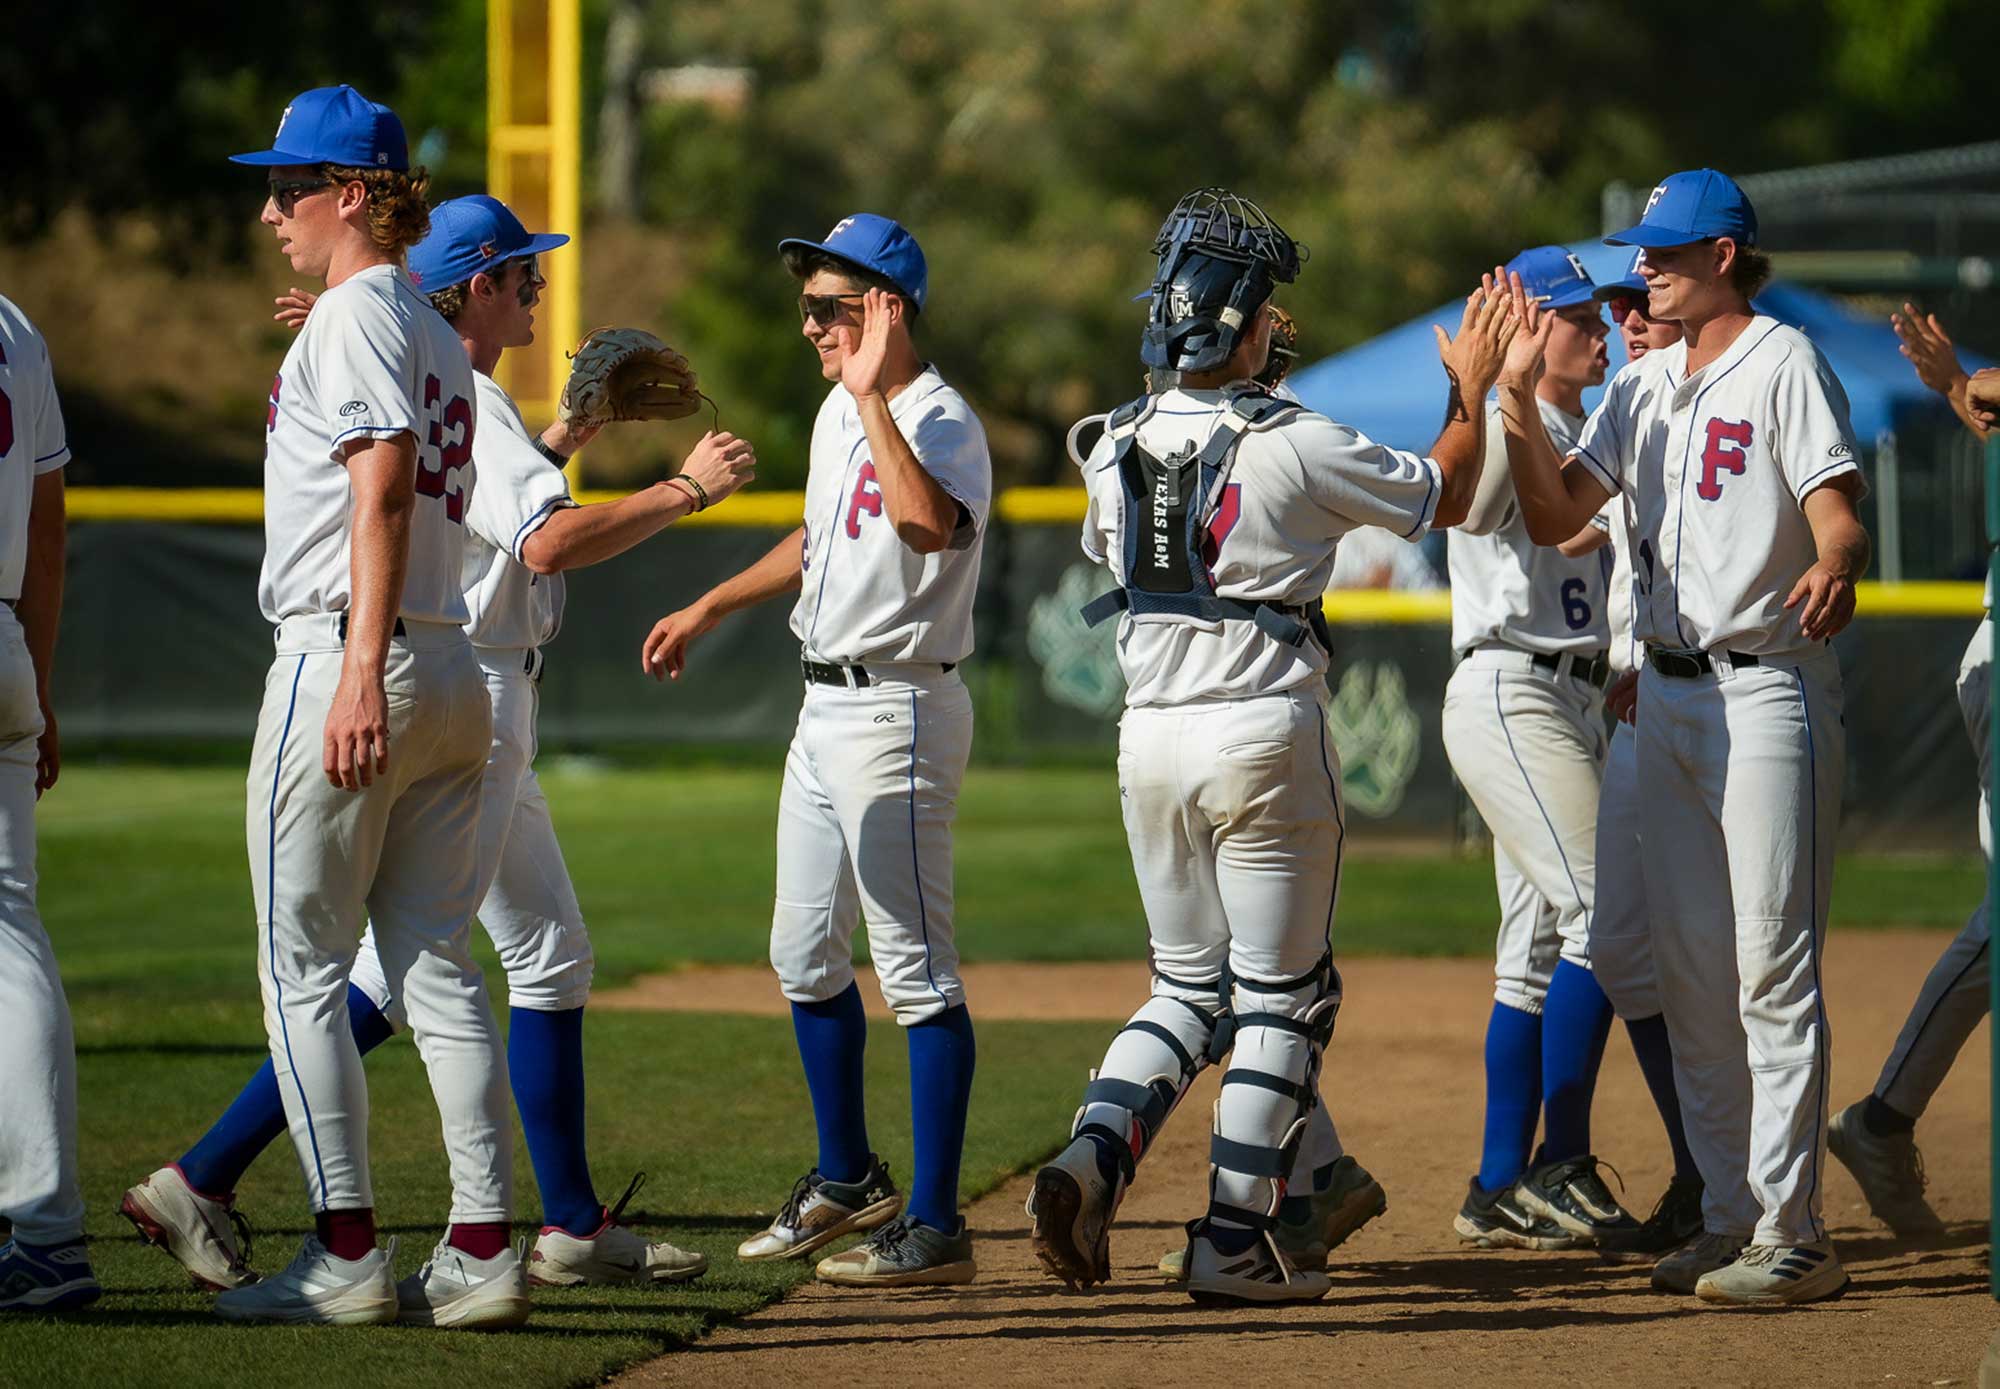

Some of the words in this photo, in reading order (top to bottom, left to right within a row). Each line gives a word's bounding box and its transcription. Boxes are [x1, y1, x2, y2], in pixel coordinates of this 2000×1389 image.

[1643, 185, 1667, 215] F
[824, 218, 855, 242] F
[415, 373, 474, 525] 32
[1696, 417, 1754, 501] F
[1154, 474, 1168, 528] TEXAS
[1154, 533, 1169, 568] A&M
[1560, 577, 1591, 630] 6
